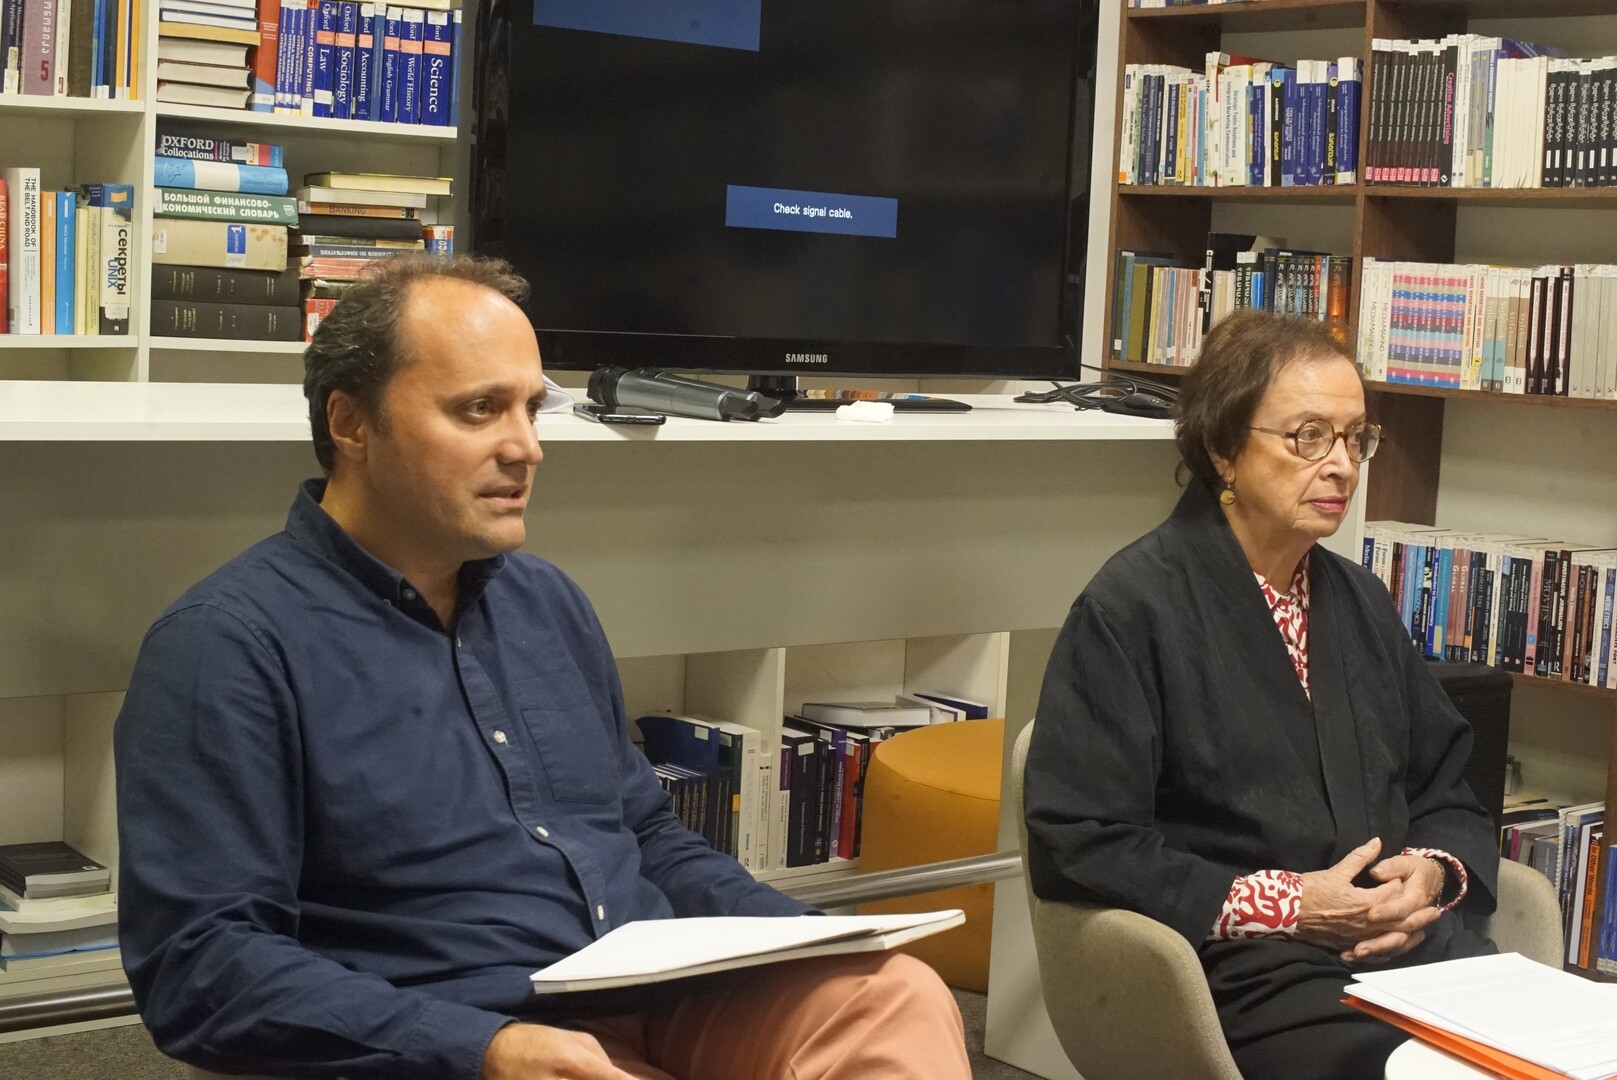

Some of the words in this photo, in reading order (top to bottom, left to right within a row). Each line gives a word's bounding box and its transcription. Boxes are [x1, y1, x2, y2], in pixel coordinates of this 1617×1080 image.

[41, 60, 49, 81] 5
[306, 47, 314, 92] COMPUTING
[320, 49, 329, 71] Law
[386, 54, 394, 78] English
[407, 57, 415, 80] World
[337, 51, 351, 103] Sociology
[358, 51, 369, 102] Accounting
[429, 57, 443, 112] Science
[405, 83, 413, 112] History
[1443, 104, 1453, 144] Advertising
[163, 136, 214, 150] OXFORD
[162, 148, 214, 160] Collocations
[162, 203, 235, 216] КОНОМИЧЕСКИЙ
[240, 206, 280, 218] СЛОВАРЬ
[164, 193, 210, 204] БОЛЬШОЙ
[214, 196, 272, 208] ФИНАНСОВО-
[329, 205, 366, 215] BANKING
[774, 203, 800, 215] Check
[803, 205, 826, 218] signal
[829, 207, 853, 218] cable.
[31, 238, 36, 247] OF
[117, 229, 128, 295] секреты
[108, 260, 118, 288] UNIX
[786, 353, 827, 363] SAMSUNG
[1542, 579, 1551, 621] MOVIES
[1568, 587, 1576, 602] Media
[1567, 603, 1575, 622] Literacy
[1587, 875, 1595, 895] Words
